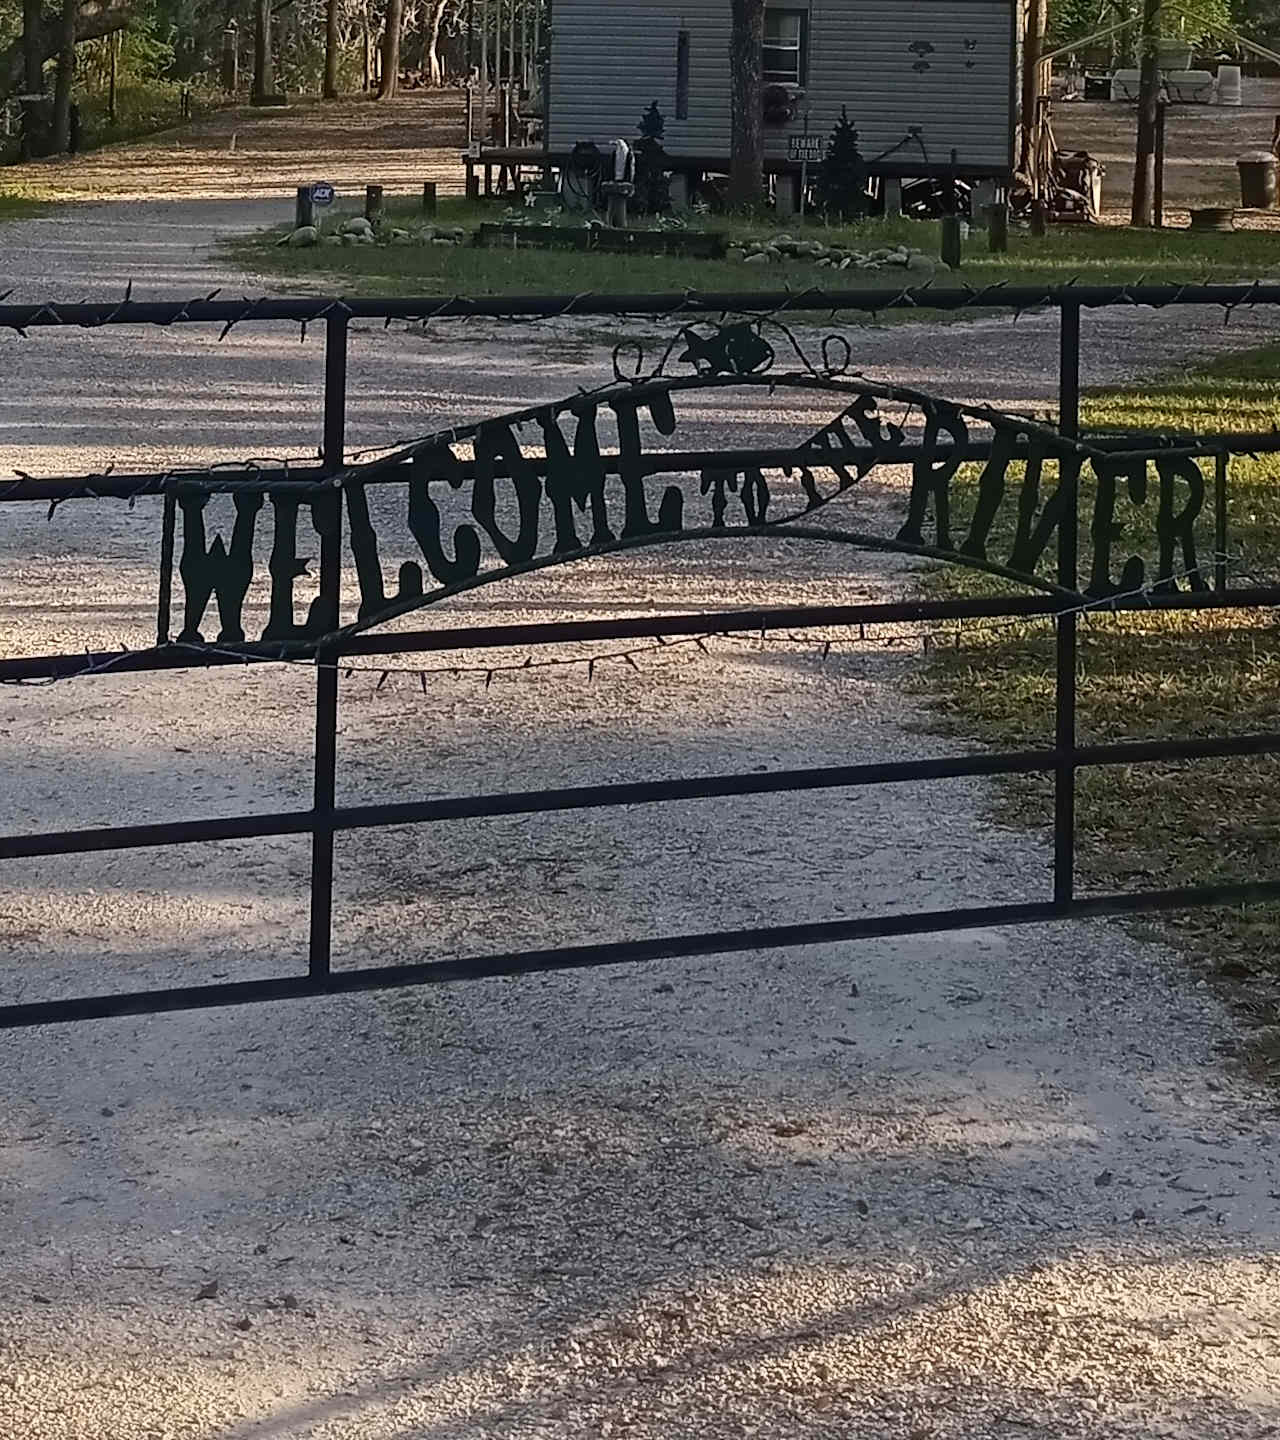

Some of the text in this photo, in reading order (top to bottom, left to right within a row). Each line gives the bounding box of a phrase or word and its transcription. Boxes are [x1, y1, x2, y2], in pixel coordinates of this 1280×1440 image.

[178, 389, 1212, 643] WELCOME TO THE RIVER
